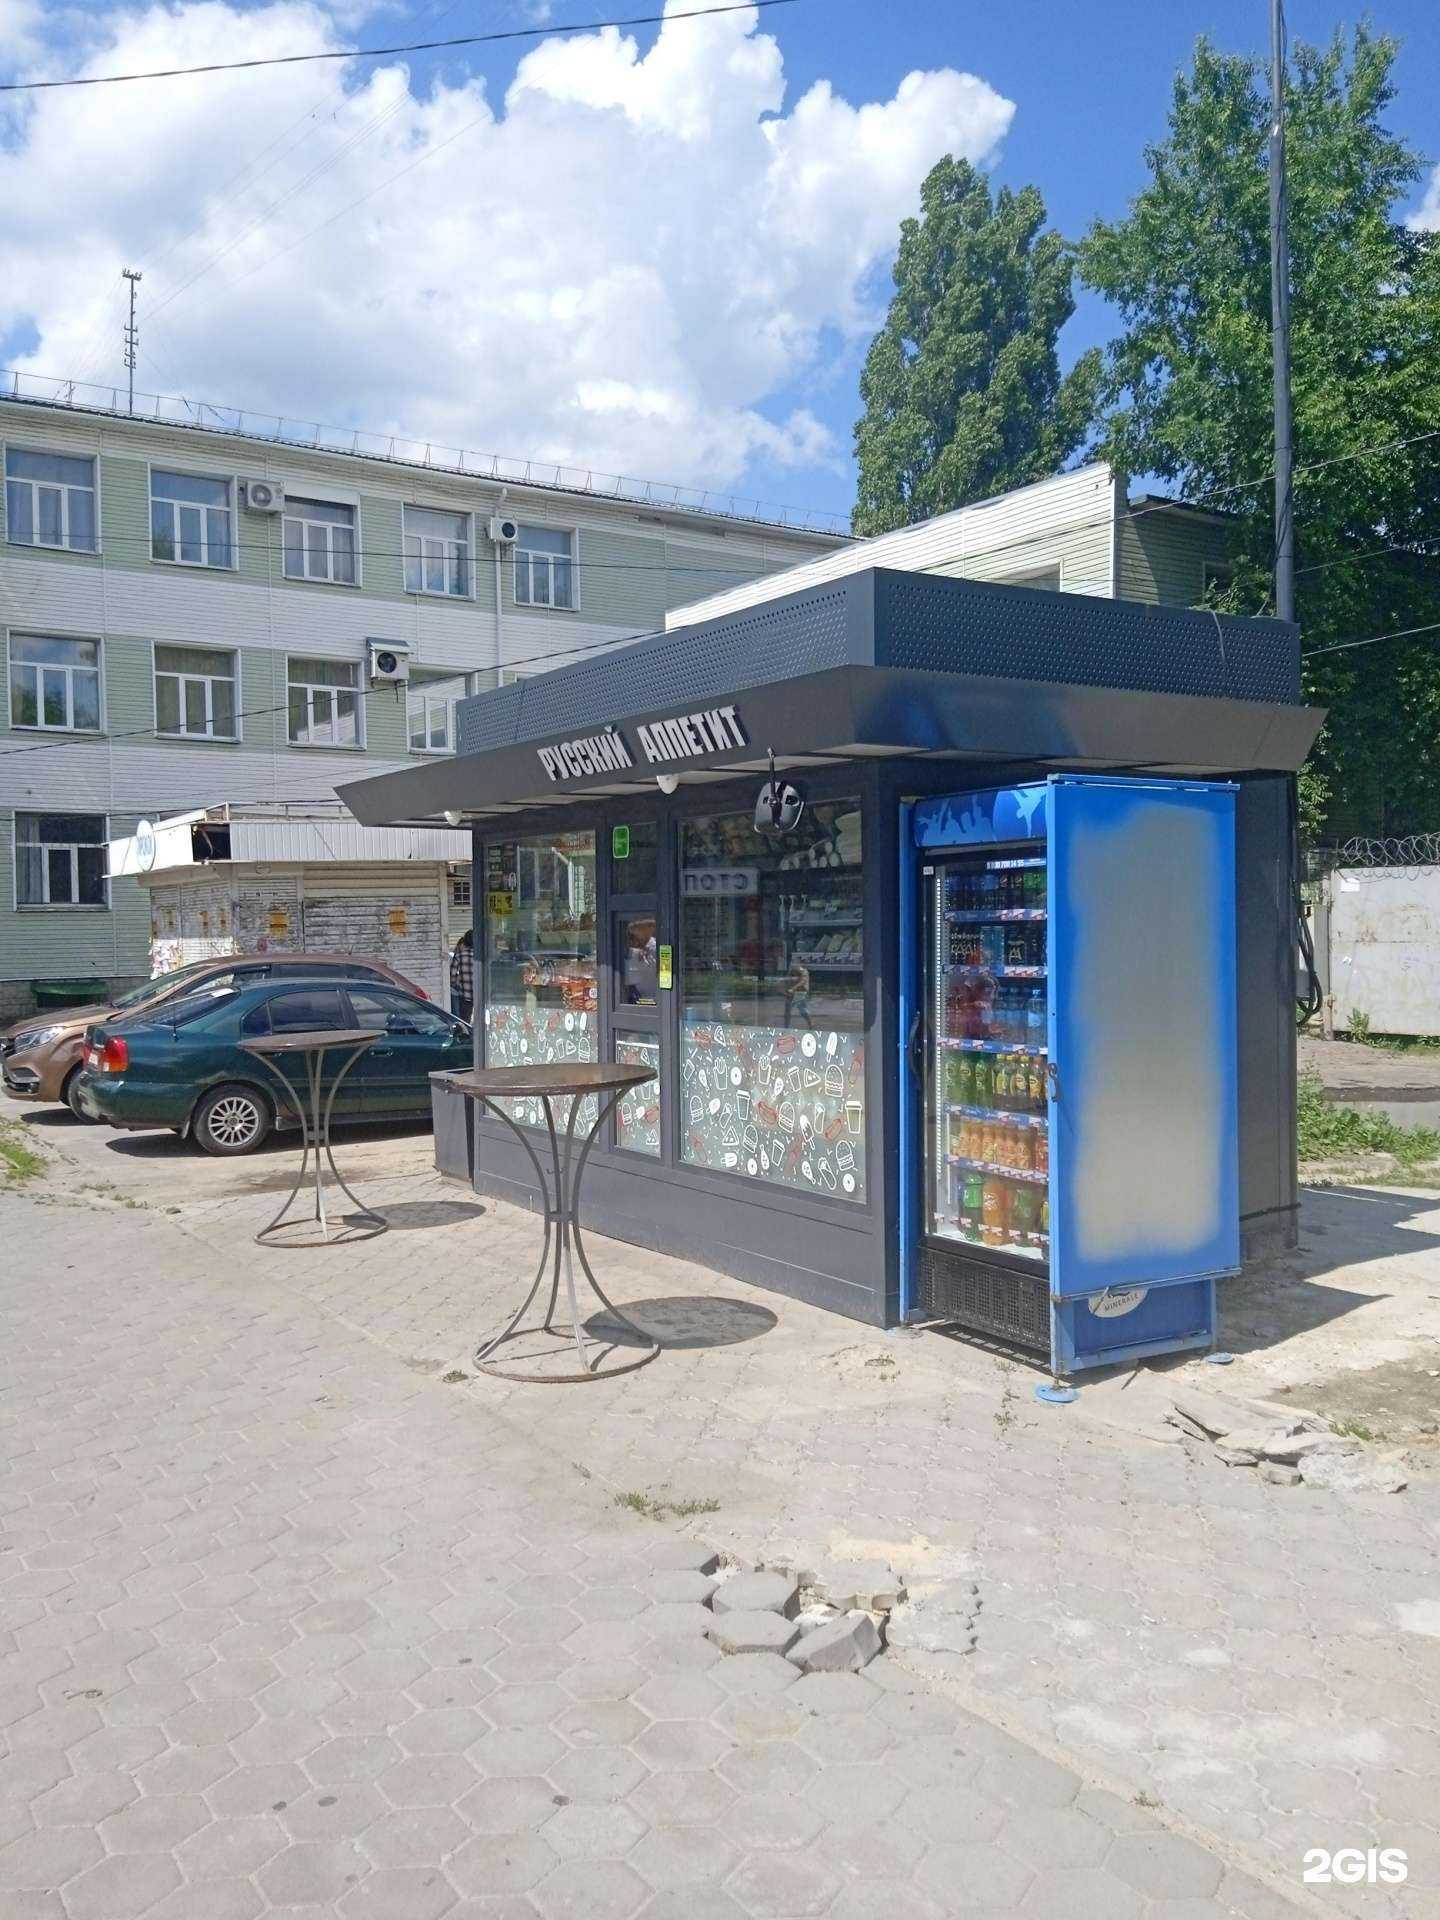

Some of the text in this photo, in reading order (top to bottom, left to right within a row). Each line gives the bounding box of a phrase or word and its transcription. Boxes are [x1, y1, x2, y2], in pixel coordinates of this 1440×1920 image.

[537, 704, 746, 781] РУССКИЙ АППЕТИТ
[1104, 1293, 1137, 1311] MINERALE
